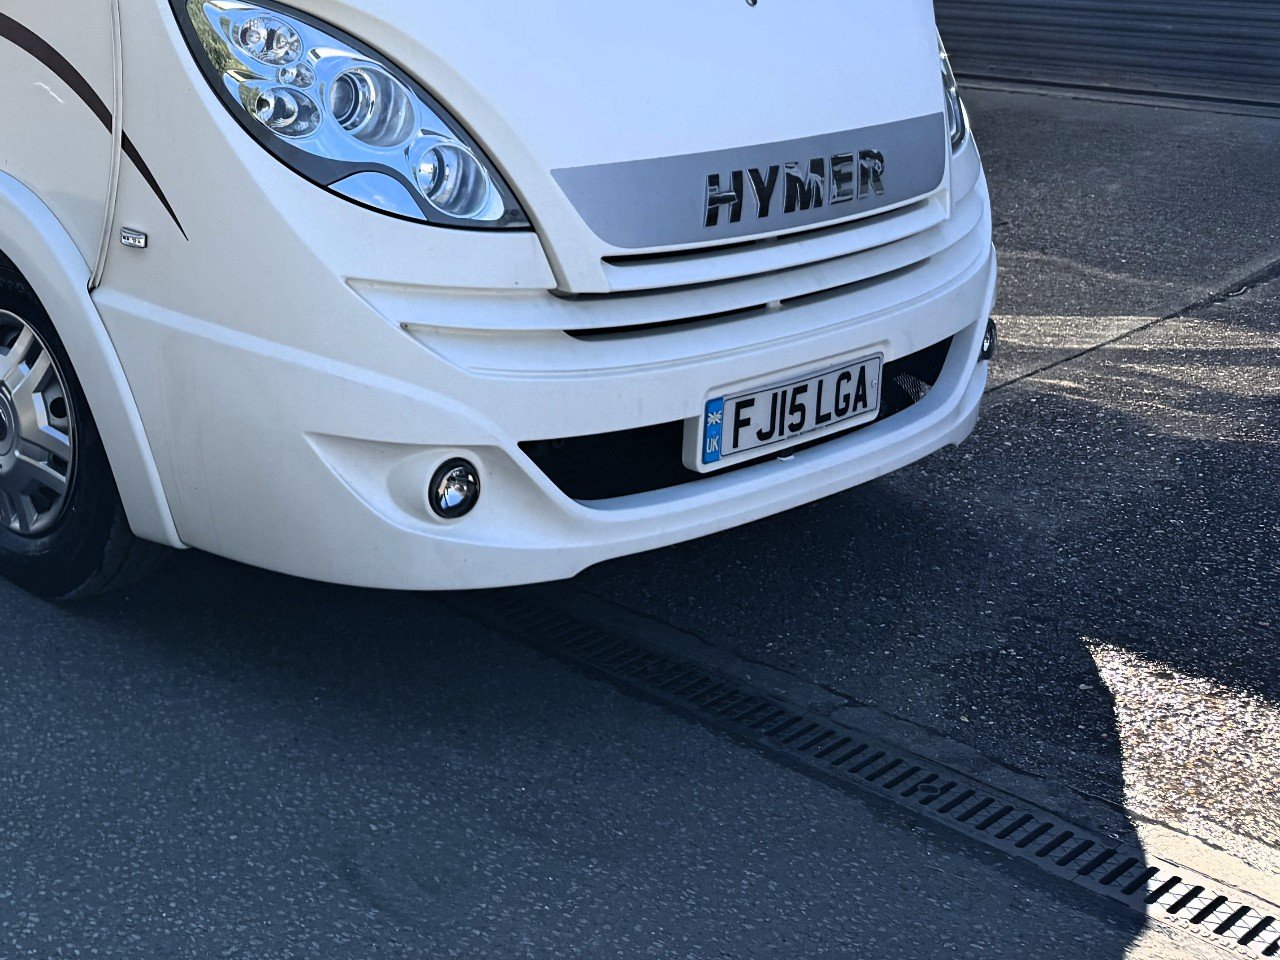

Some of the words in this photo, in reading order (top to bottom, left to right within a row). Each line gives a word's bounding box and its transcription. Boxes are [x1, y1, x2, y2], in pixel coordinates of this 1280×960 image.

[703, 148, 885, 228] HYMER
[706, 435, 720, 453] UK
[732, 383, 809, 449] FJ15
[815, 365, 868, 426] LGA
